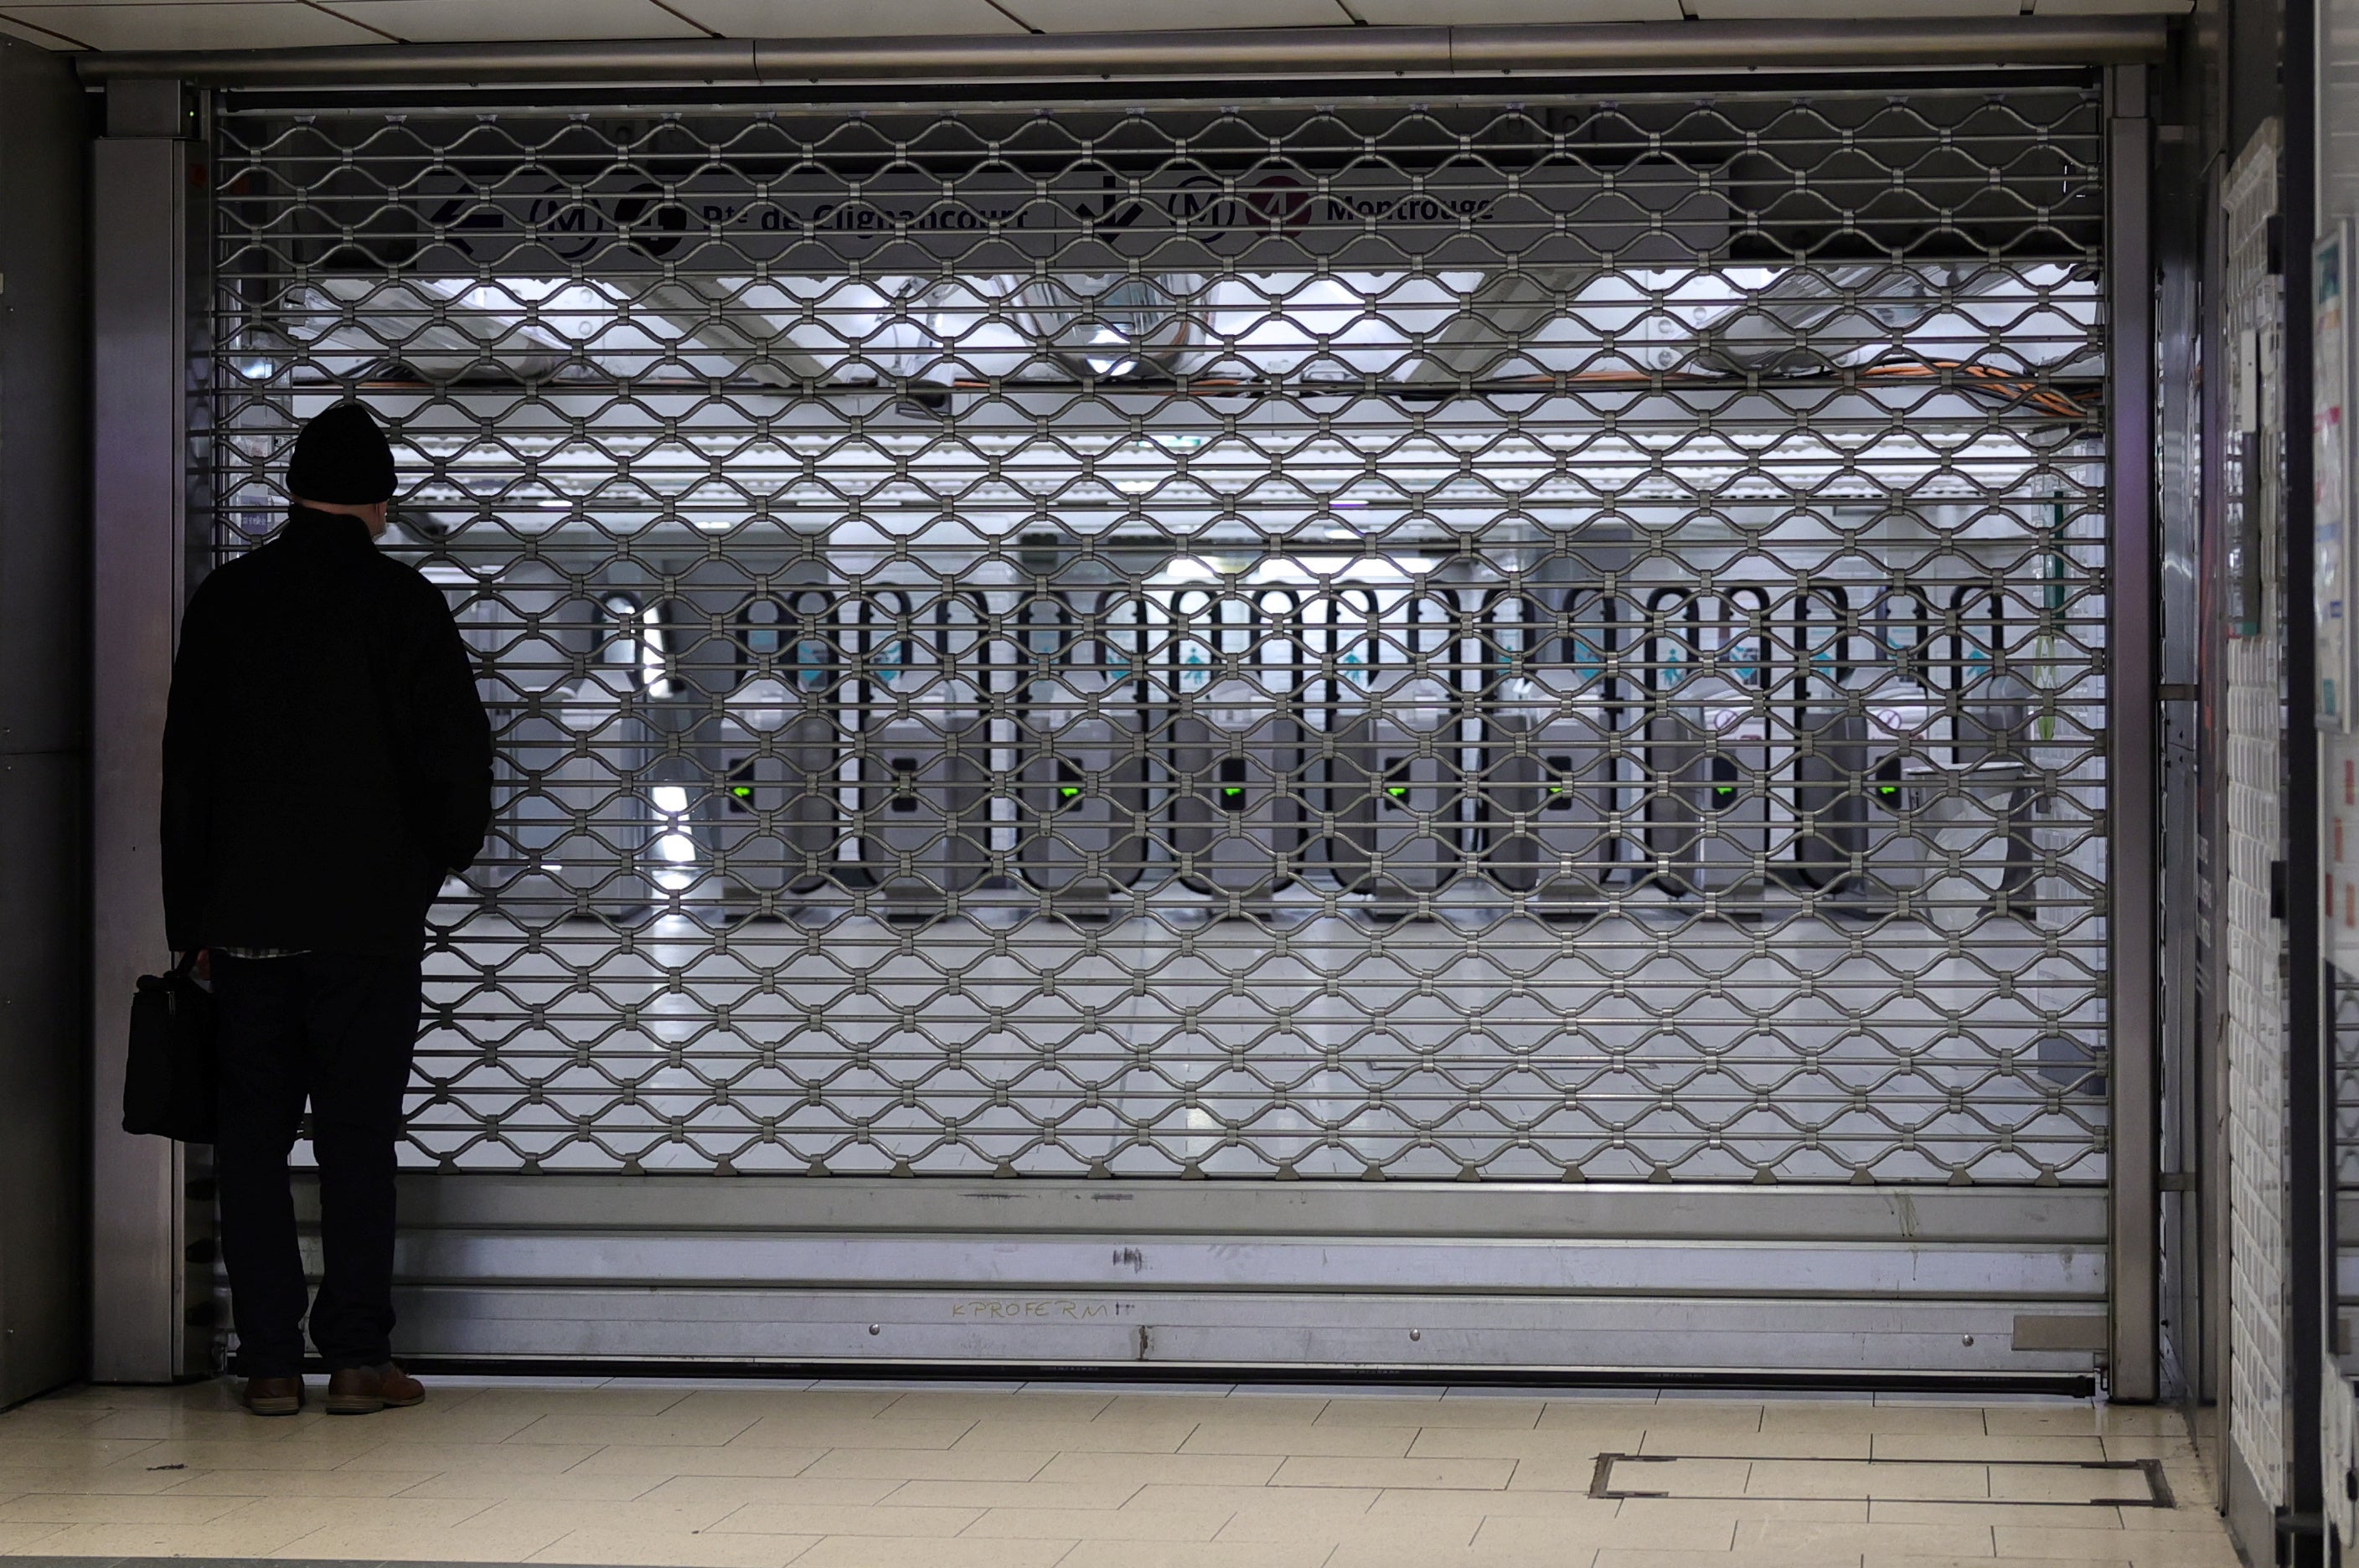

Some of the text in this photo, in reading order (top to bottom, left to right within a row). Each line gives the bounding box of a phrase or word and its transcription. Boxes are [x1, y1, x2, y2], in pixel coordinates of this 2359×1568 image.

[761, 204, 801, 230] de
[813, 204, 1030, 240] Clignancourt
[1326, 194, 1495, 230] Montrouge
